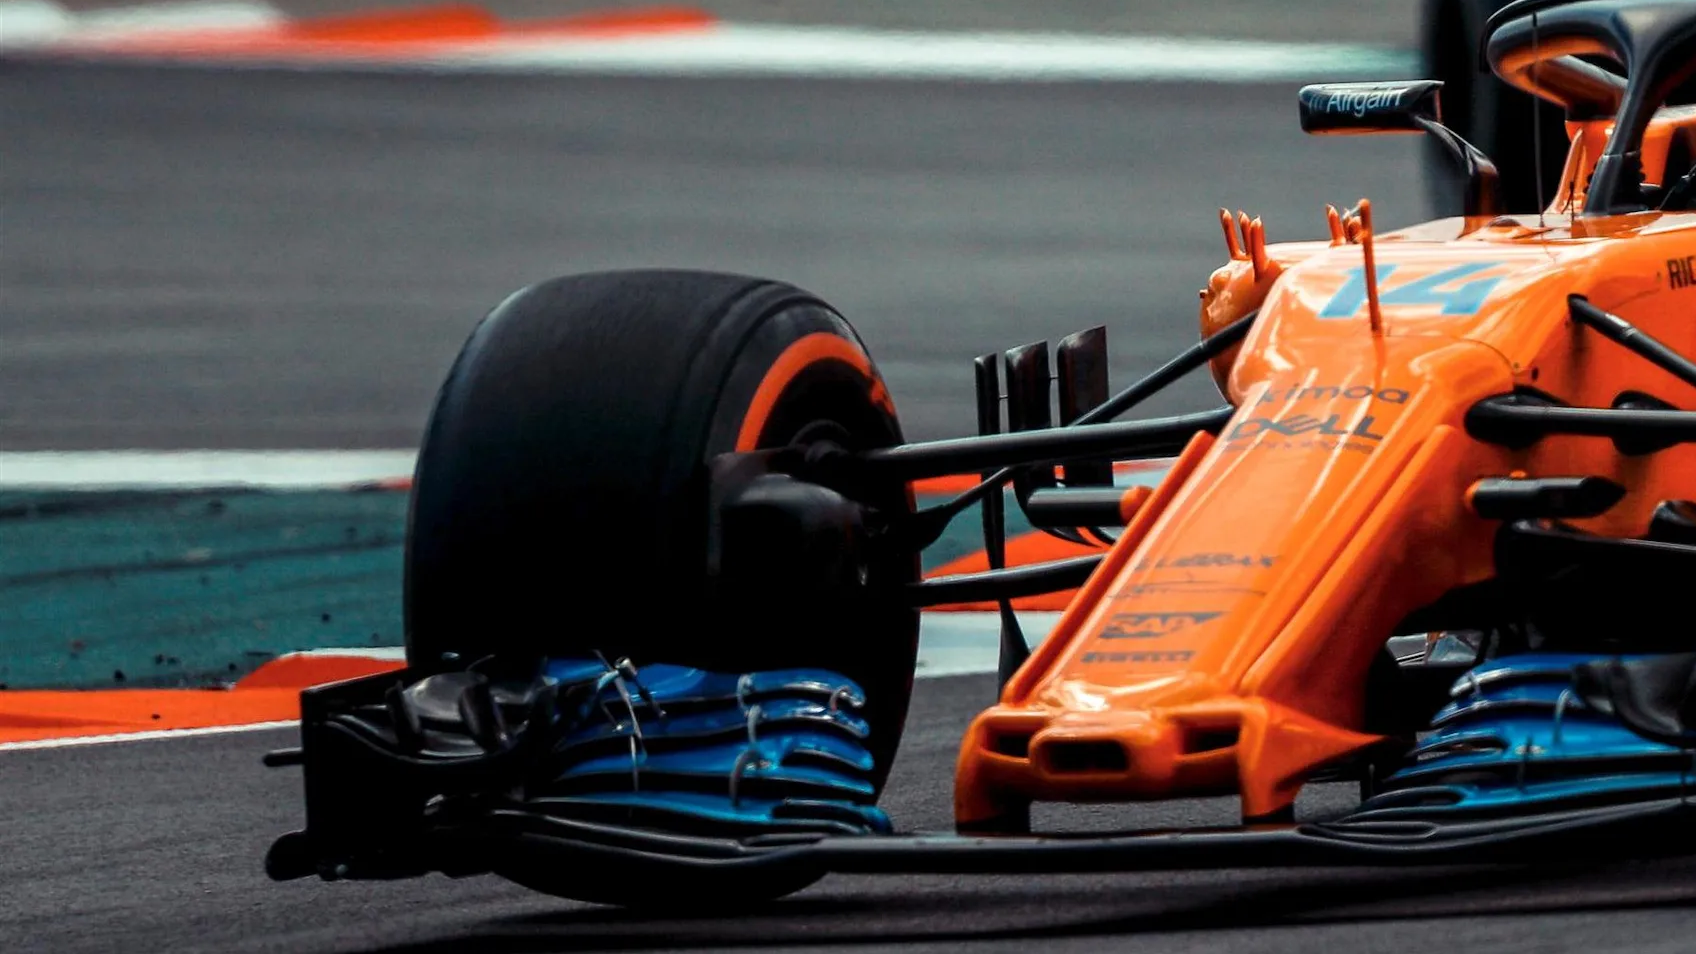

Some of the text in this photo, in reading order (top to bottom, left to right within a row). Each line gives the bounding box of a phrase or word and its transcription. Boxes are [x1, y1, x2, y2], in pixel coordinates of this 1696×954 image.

[1326, 88, 1402, 117] Airgain
[1321, 262, 1510, 317] 14
[1256, 383, 1409, 404] kimoa
[1228, 415, 1384, 441] DELL
